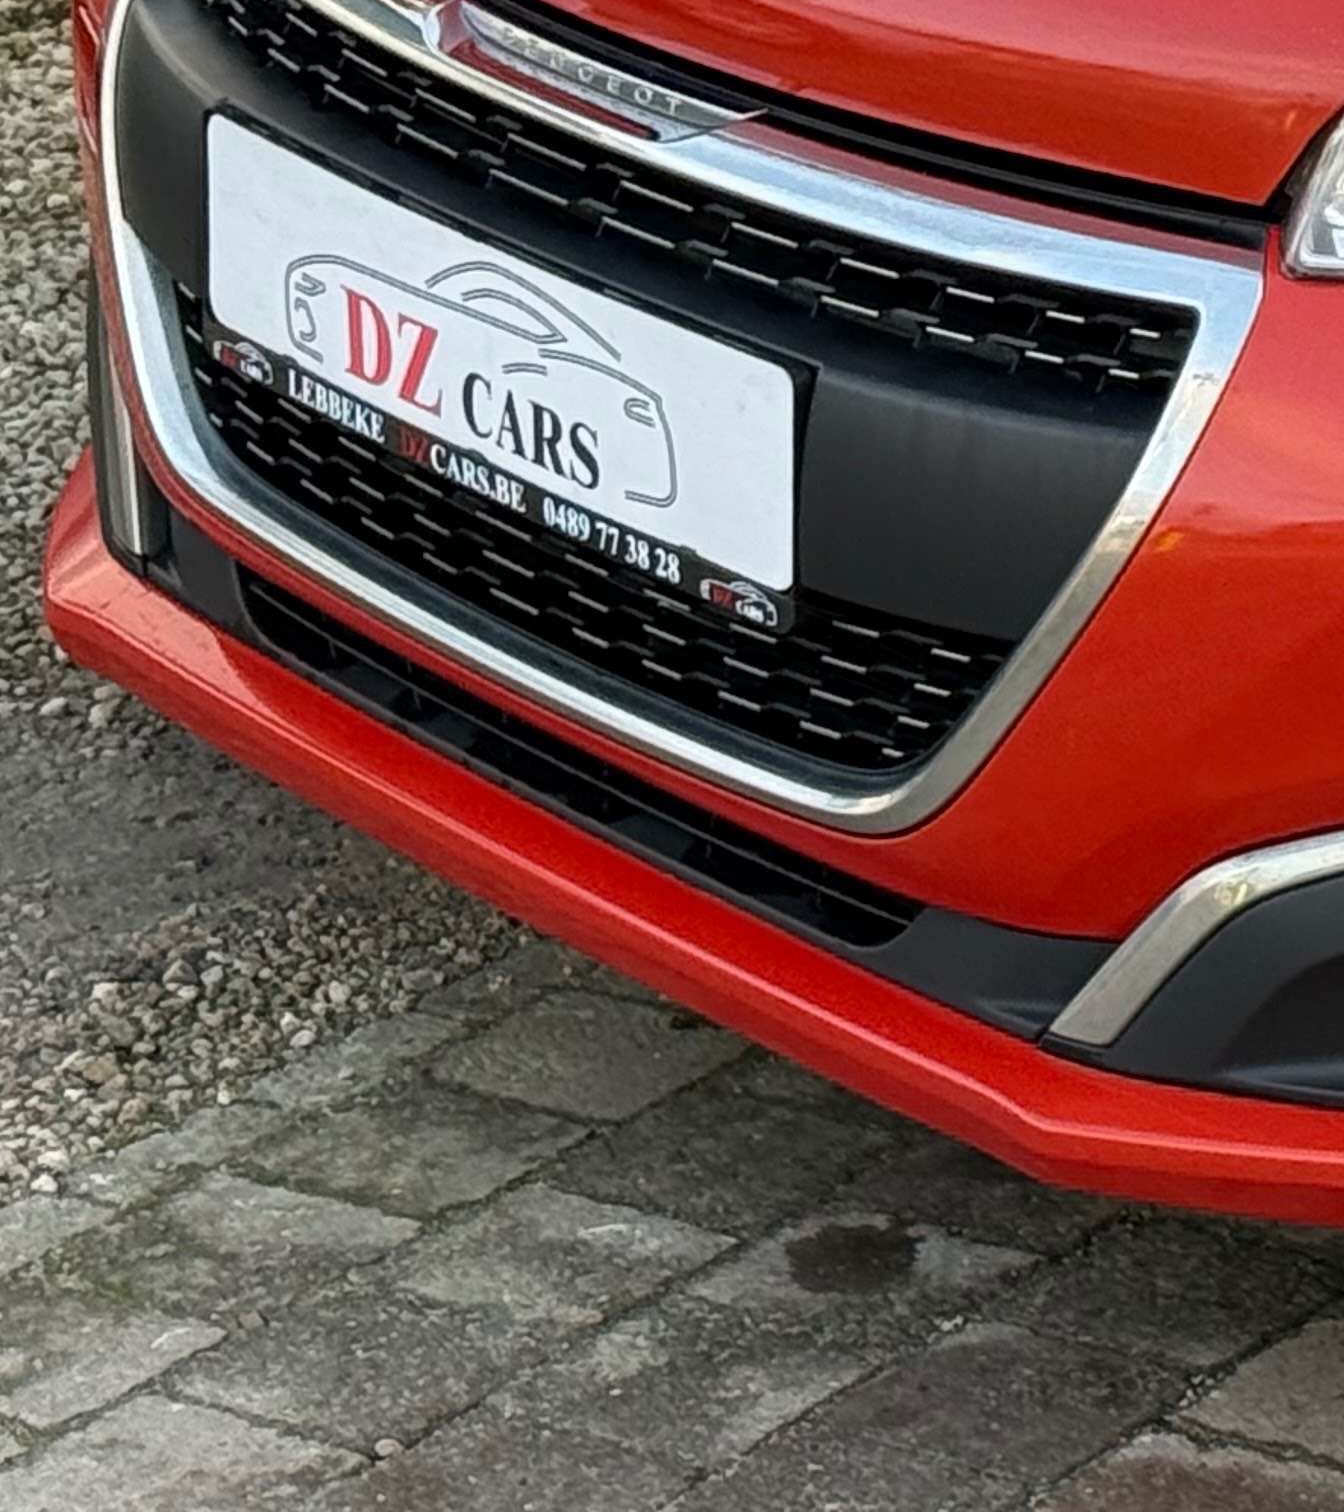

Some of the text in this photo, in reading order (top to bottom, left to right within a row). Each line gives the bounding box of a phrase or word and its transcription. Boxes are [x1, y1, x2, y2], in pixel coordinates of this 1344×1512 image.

[500, 26, 683, 116] PEUGEOT
[288, 368, 386, 443] LEBBEKE
[543, 496, 591, 542] 0489
[595, 521, 620, 557] 77
[624, 534, 651, 571] 38
[654, 548, 681, 585] 28
[340, 284, 599, 490] DZ CARS
